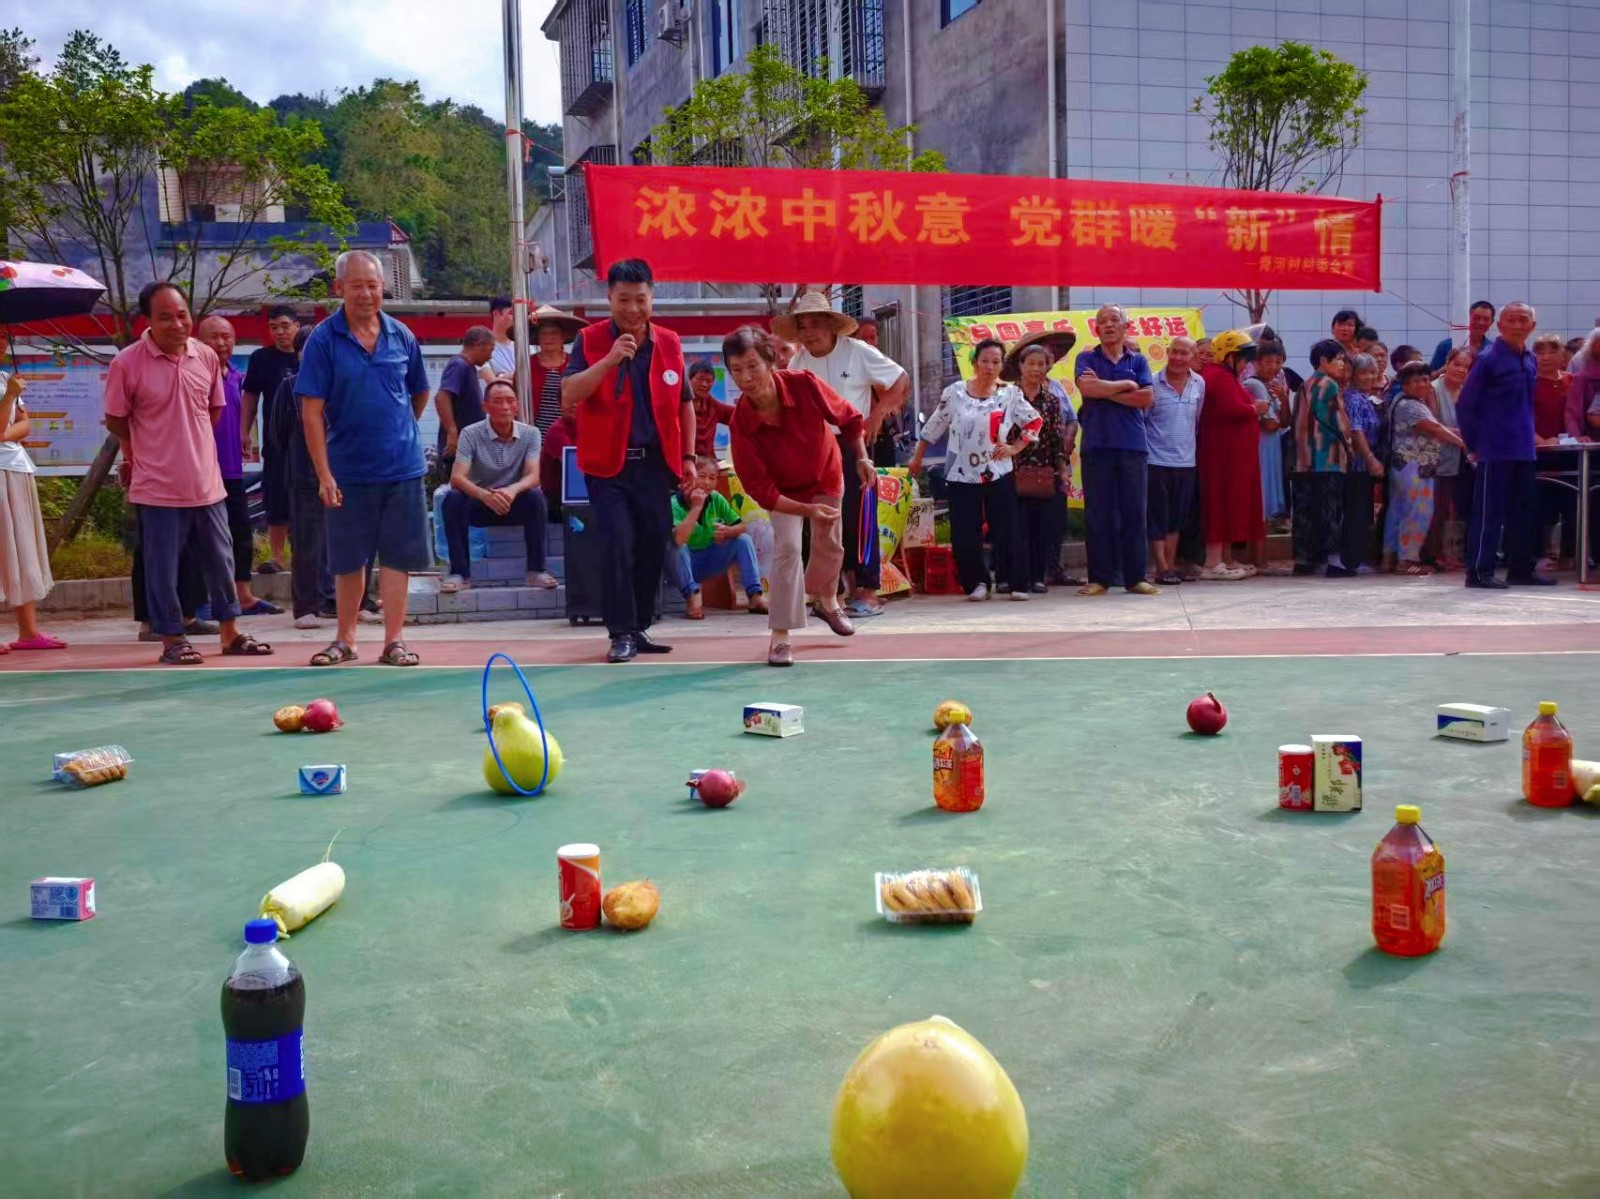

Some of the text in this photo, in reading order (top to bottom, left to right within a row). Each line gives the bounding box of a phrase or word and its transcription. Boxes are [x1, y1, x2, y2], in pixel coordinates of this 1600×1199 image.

[634, 185, 973, 246] 浓浓中秋意
